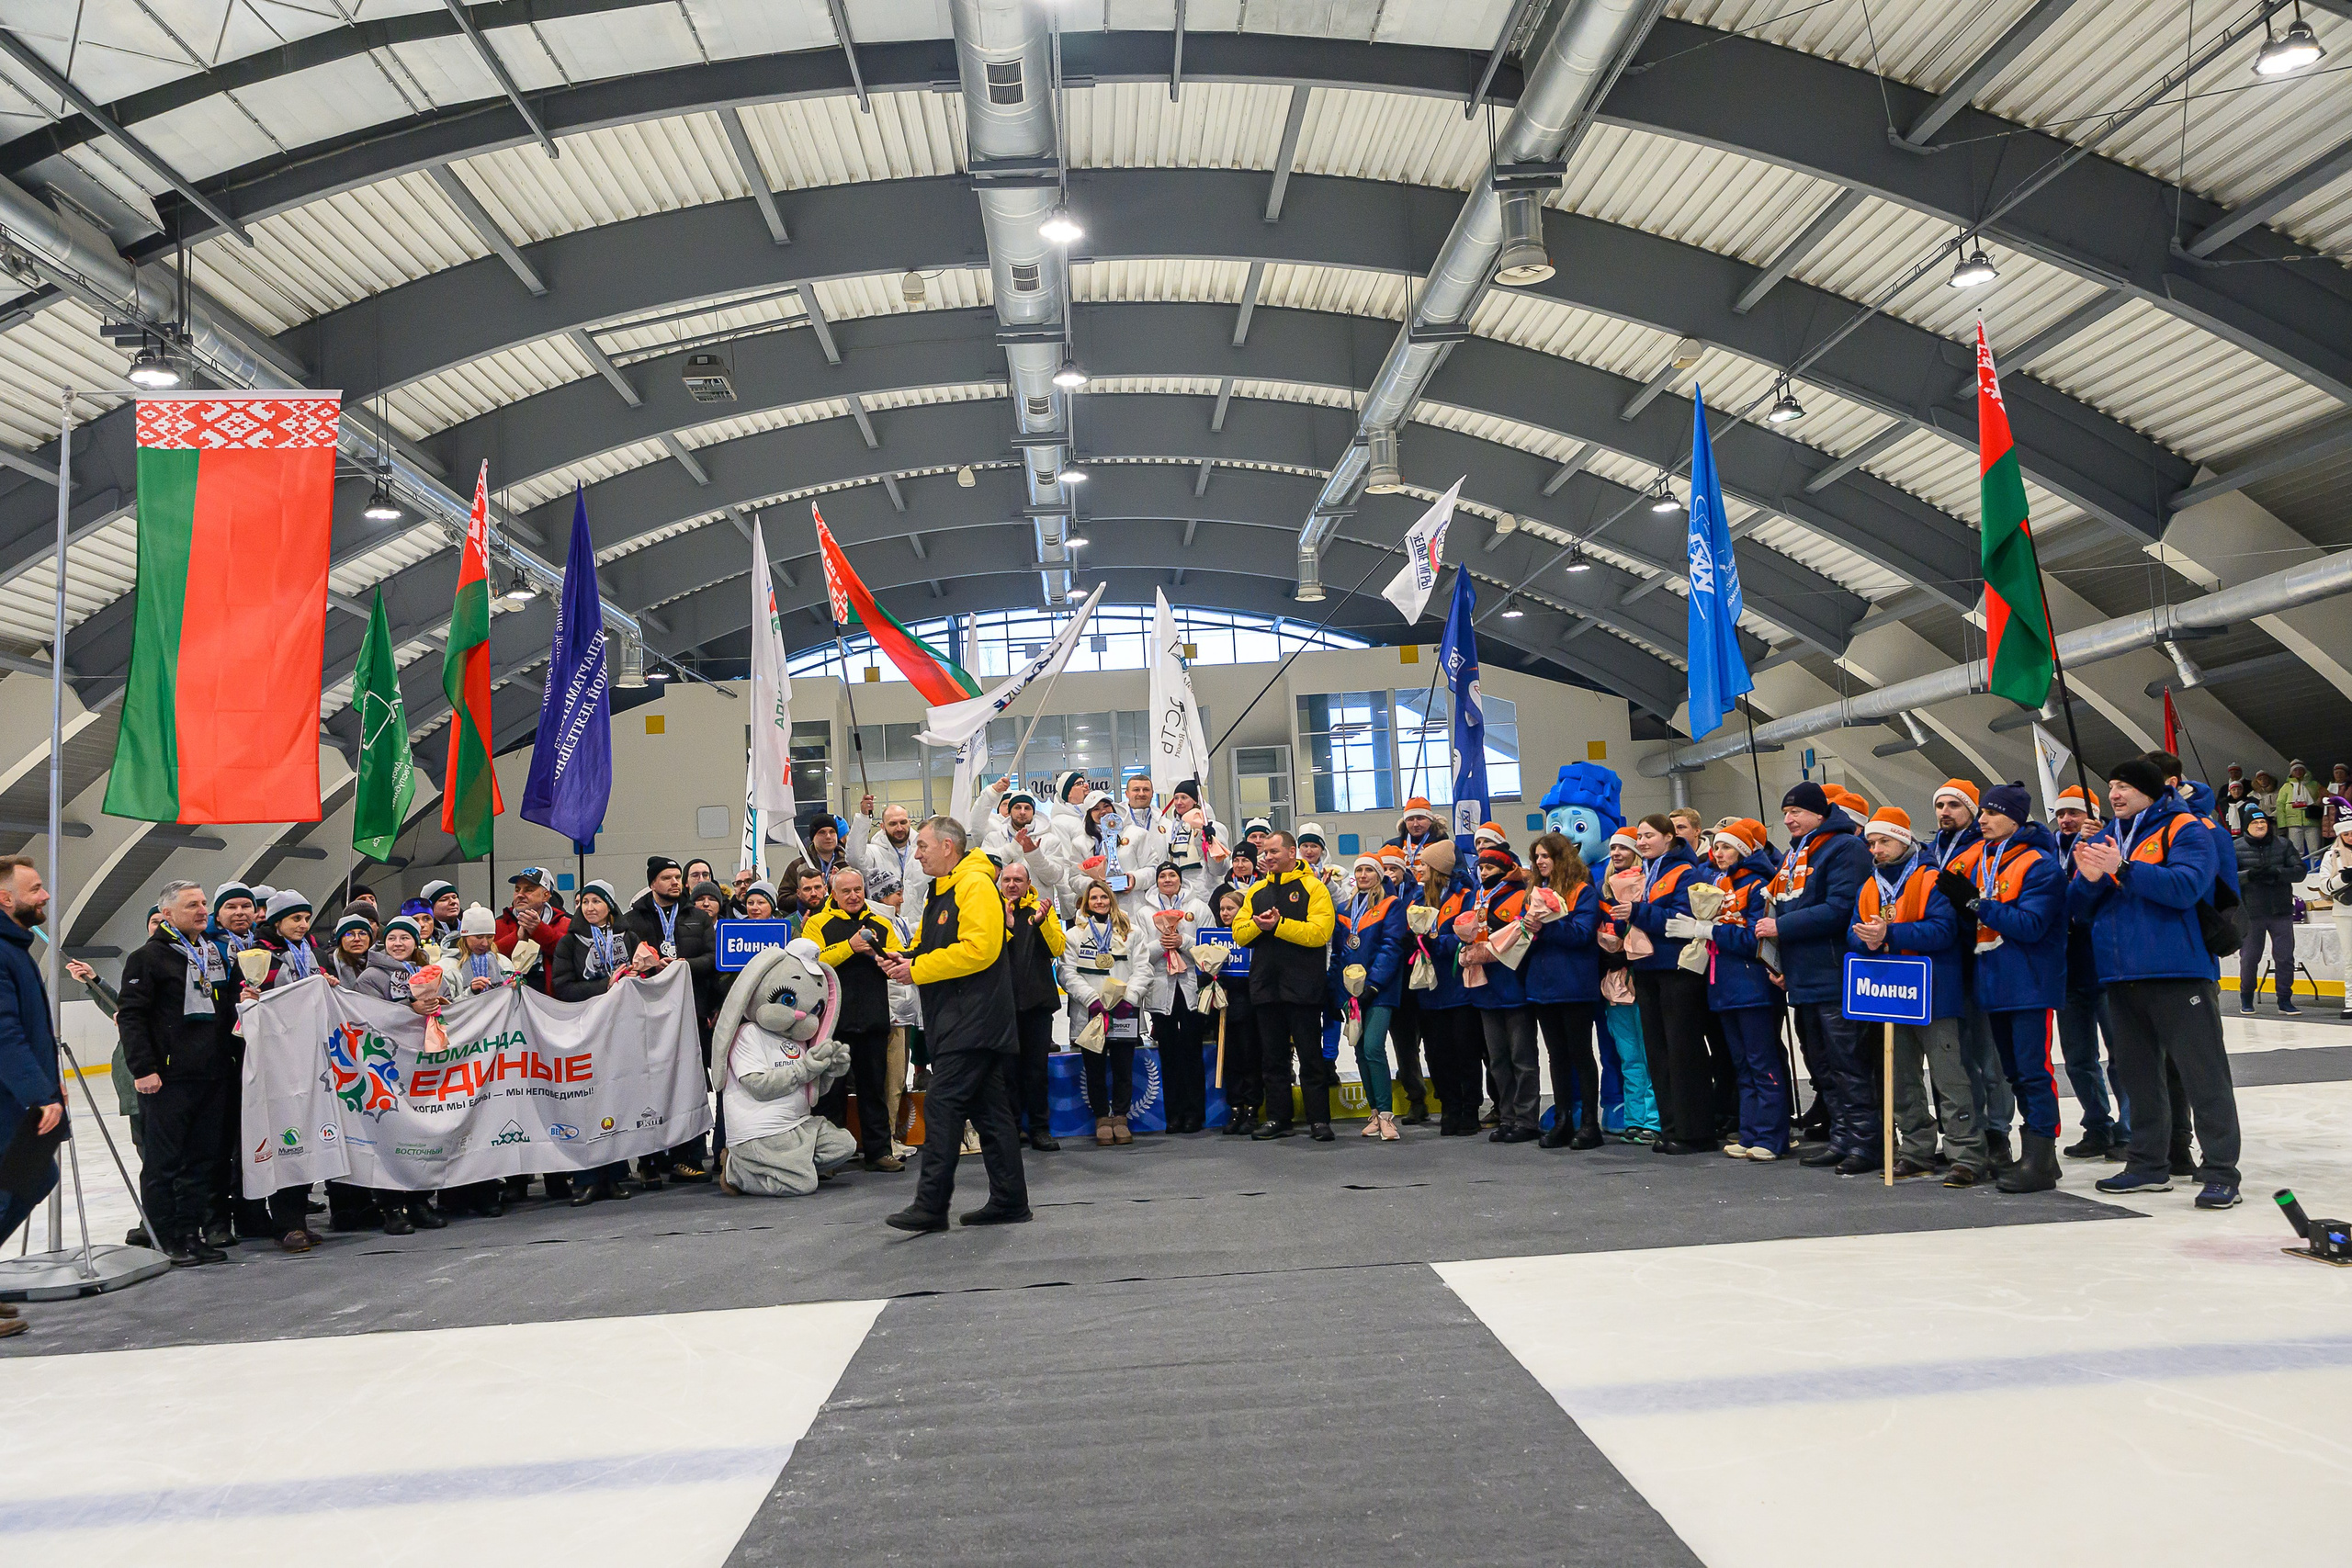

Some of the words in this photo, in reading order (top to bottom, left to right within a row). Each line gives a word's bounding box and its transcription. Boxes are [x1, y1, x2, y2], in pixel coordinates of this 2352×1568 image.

[1419, 561, 1433, 590] ТИГРЫ
[1856, 977, 1917, 1000] Молния
[416, 1031, 527, 1065] КОМАНДА
[409, 1052, 593, 1101] ЕДИНЫЕ
[413, 1103, 445, 1115] КОГДА
[447, 1100, 466, 1111] МЫ
[469, 1092, 492, 1107] ЕДИНЫ
[506, 1088, 524, 1097] МЫ
[526, 1087, 594, 1101] НЕПОБЕДИМЫ!
[395, 1146, 444, 1156] ВОСТОЧНЫЙ
